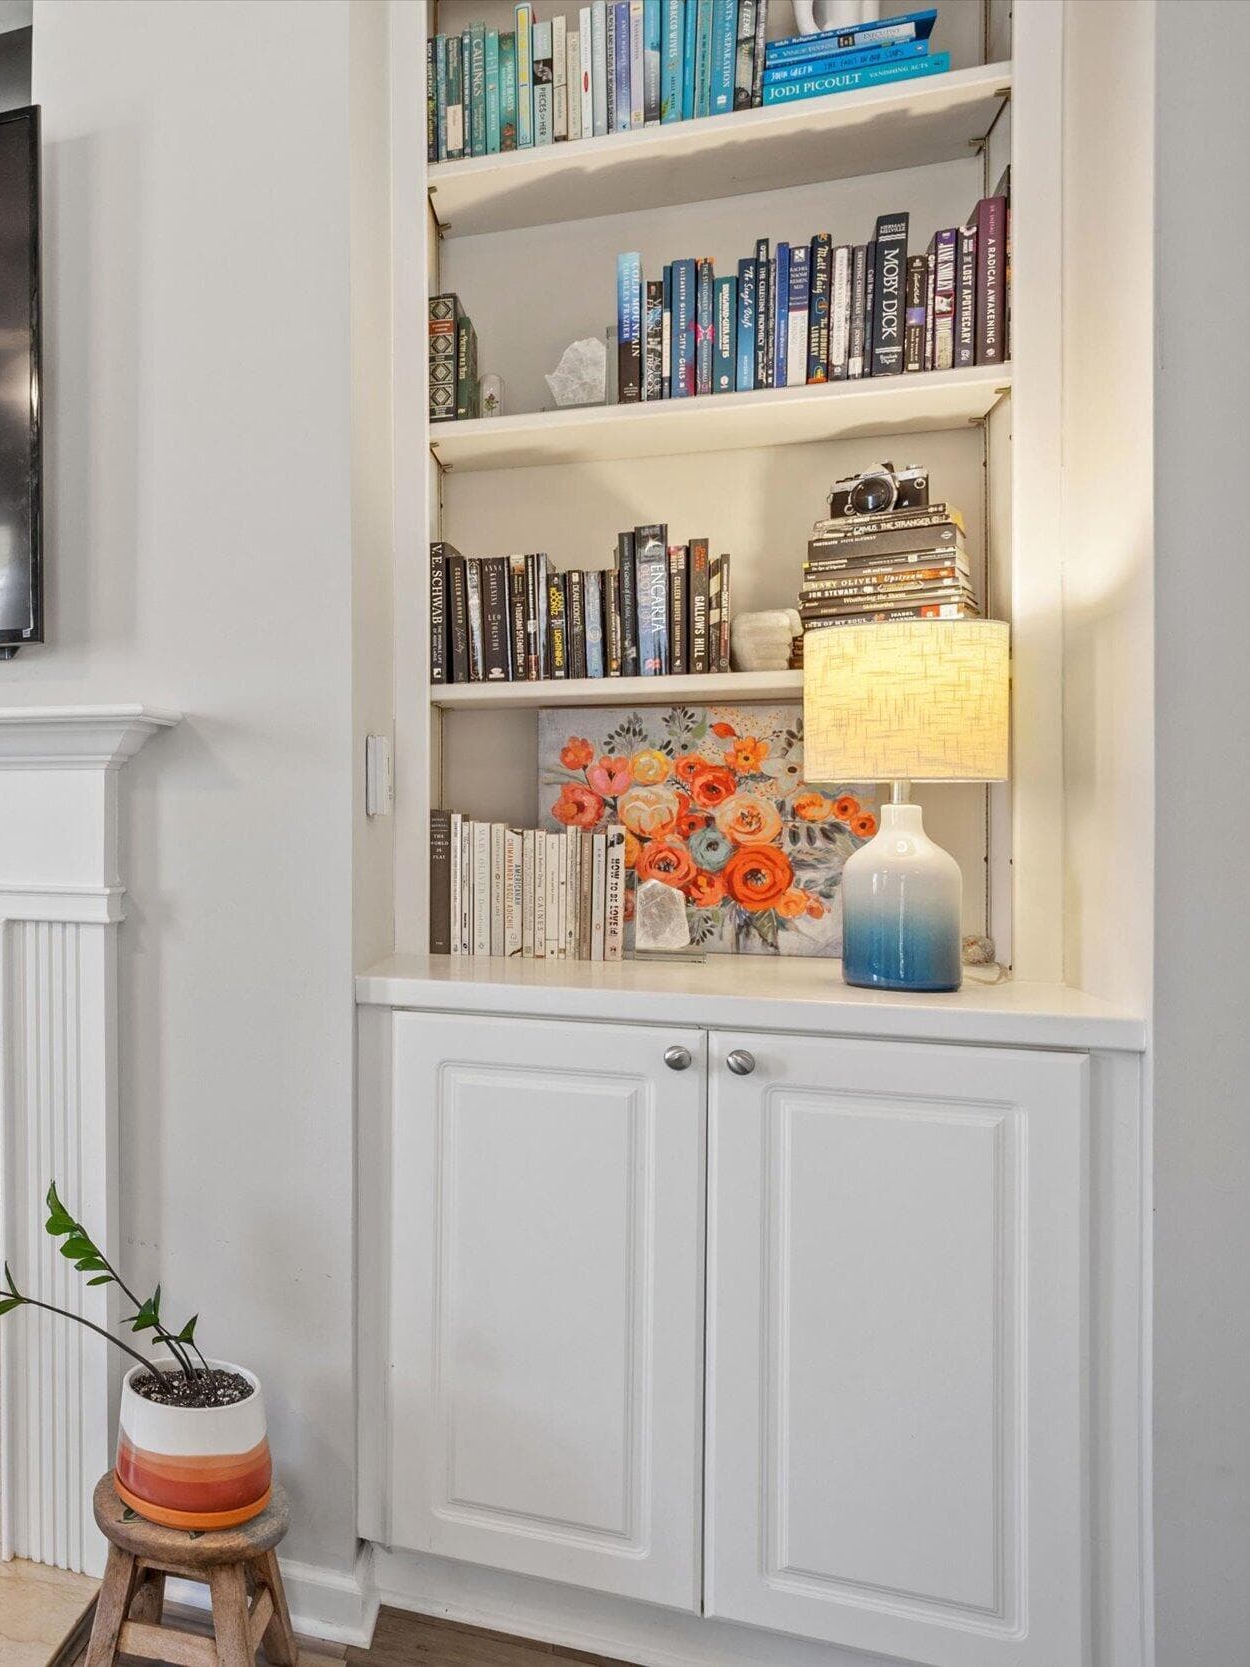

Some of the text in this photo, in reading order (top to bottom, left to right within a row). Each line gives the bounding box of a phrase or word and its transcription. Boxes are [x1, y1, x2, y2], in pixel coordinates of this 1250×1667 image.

[669, 32, 678, 58] WIVES
[472, 38, 483, 97] CALLINGS
[790, 65, 813, 77] GREEN
[910, 62, 929, 72] ACTS
[538, 87, 546, 113] PIECES
[769, 73, 862, 100] JODI PICOULT
[539, 121, 547, 137] HER
[743, 265, 754, 282] The
[758, 267, 766, 280] THE
[812, 245, 828, 294] Matt Haig
[963, 264, 971, 286] LOST
[987, 247, 995, 287] RADICAL
[622, 263, 630, 339] CHARLES FRAZIER
[631, 261, 640, 357] COLD MOUNTAIN
[758, 280, 766, 313] CELESTINE
[855, 278, 863, 315] CHRISTMAS
[881, 247, 900, 341] MOBY DICK
[654, 298, 662, 332] VINCE
[757, 314, 766, 346] PROPHECY
[961, 289, 971, 344] APOTHECARY
[986, 289, 994, 344] AWAKENING
[810, 325, 819, 357] LIBRARY
[819, 328, 827, 363] MIDNIGHT
[678, 358, 686, 379] GIRLS
[853, 517, 932, 534] CAMUS THE STRANGER
[431, 544, 443, 624] V. E. SCHWAB
[810, 573, 923, 589] MARY OLIVER Upstream
[824, 587, 859, 597] STEWART
[454, 567, 464, 654] COLLEEN HOOVER Verity
[549, 587, 558, 616] KOONTZ
[572, 602, 581, 625] KOONTZ
[640, 564, 651, 634] QUOTATIONS
[650, 563, 666, 633] ENCARTA
[515, 606, 523, 630] THOUSAND
[694, 596, 705, 658] GALLOWS HILL
[491, 621, 499, 652] TOLSTOY
[516, 630, 524, 653] SPLENDID
[554, 629, 563, 667] LIGHTNING
[477, 858, 487, 895] OLIVER
[506, 839, 514, 929] CHIMAMANDA NGOZI ADICHIE
[610, 858, 620, 880] HOW
[610, 882, 619, 891] TO
[610, 893, 618, 903] BE
